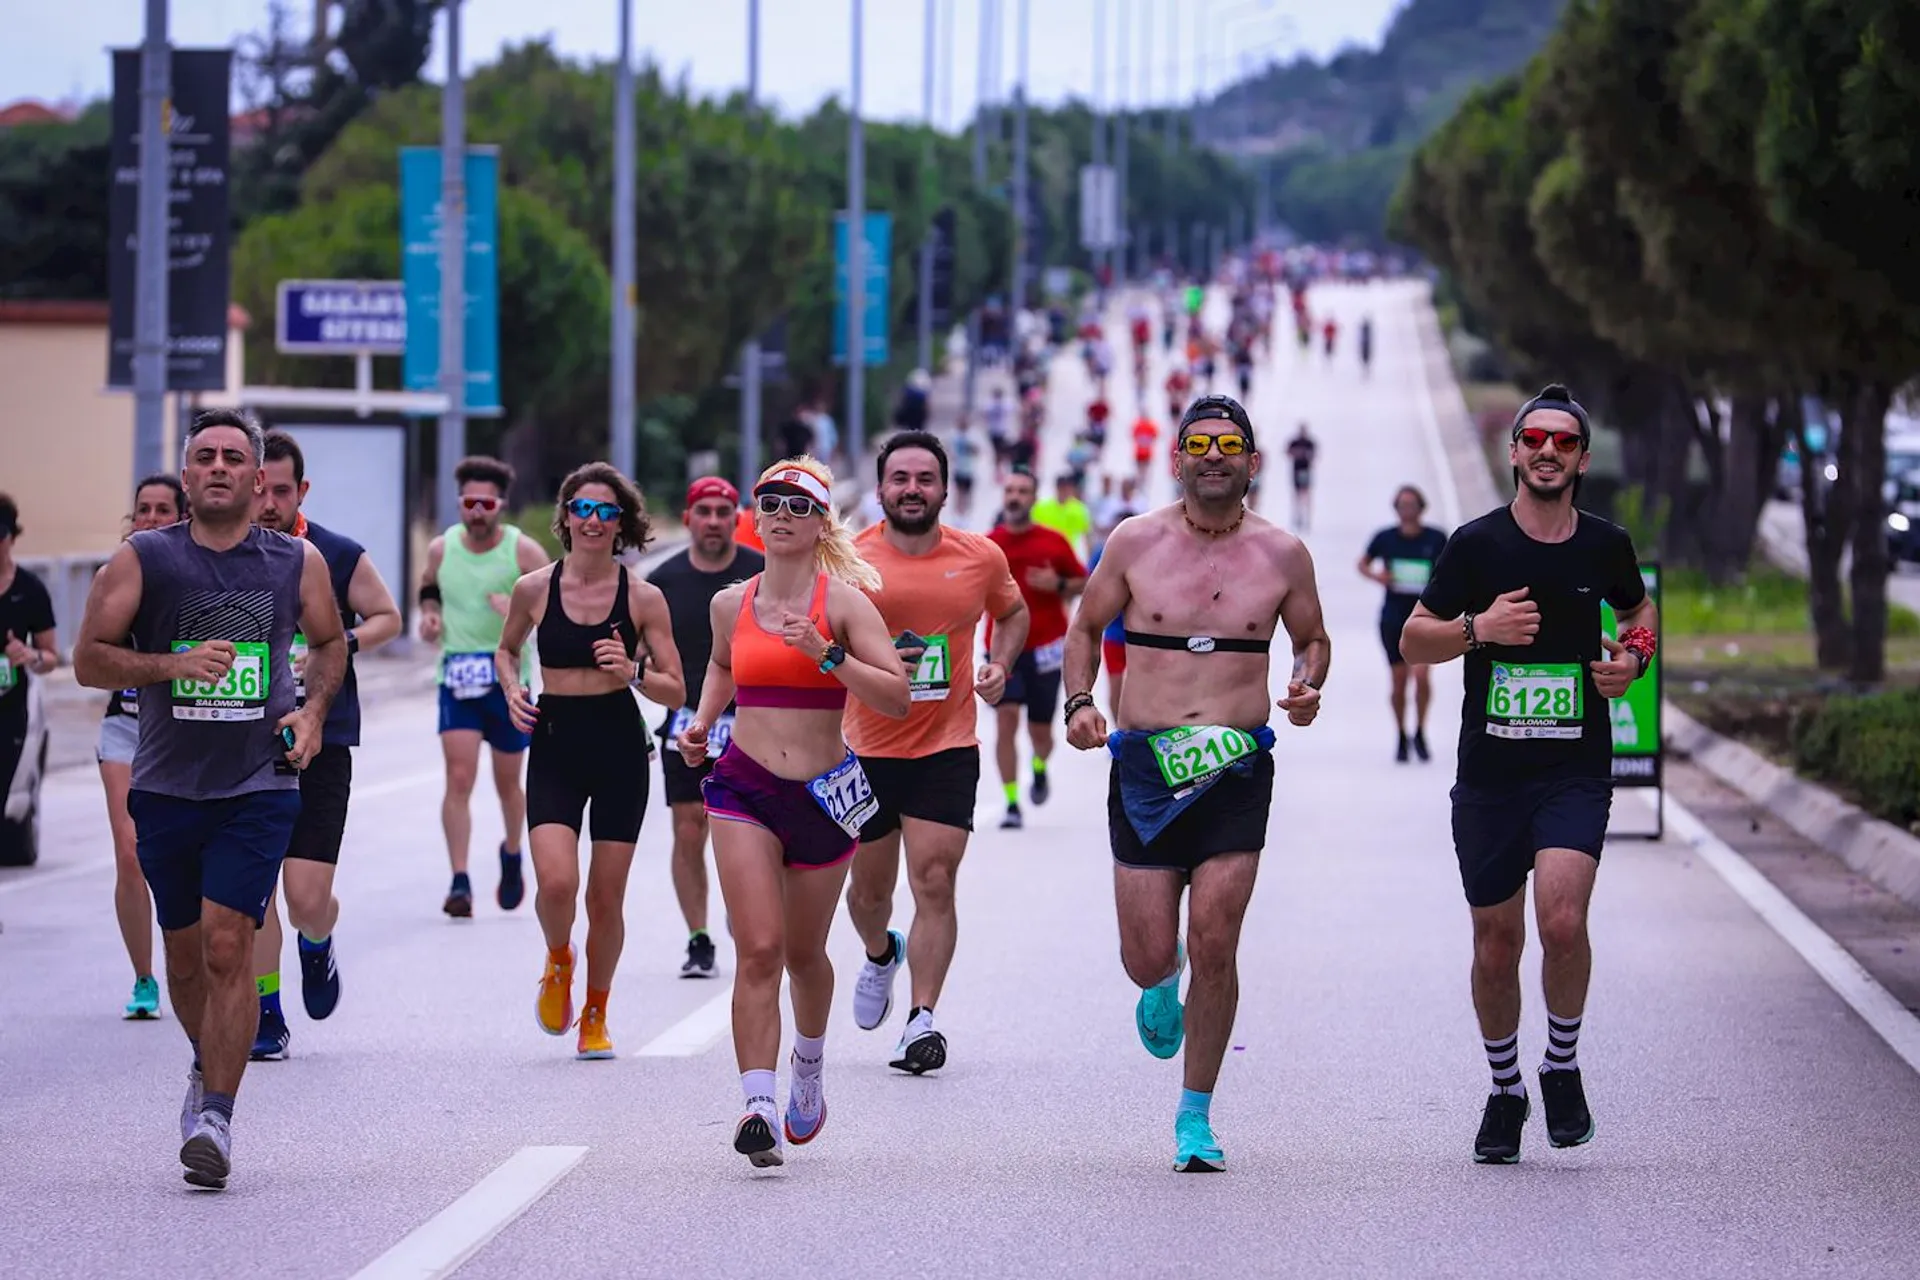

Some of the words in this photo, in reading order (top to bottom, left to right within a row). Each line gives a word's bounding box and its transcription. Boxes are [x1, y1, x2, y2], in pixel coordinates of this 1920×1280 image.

[302, 292, 407, 314] SAKARY
[195, 699, 245, 708] SALOMON
[1494, 686, 1572, 716] 6128
[1509, 718, 1558, 727] SALOMON
[1167, 731, 1243, 780] 6210
